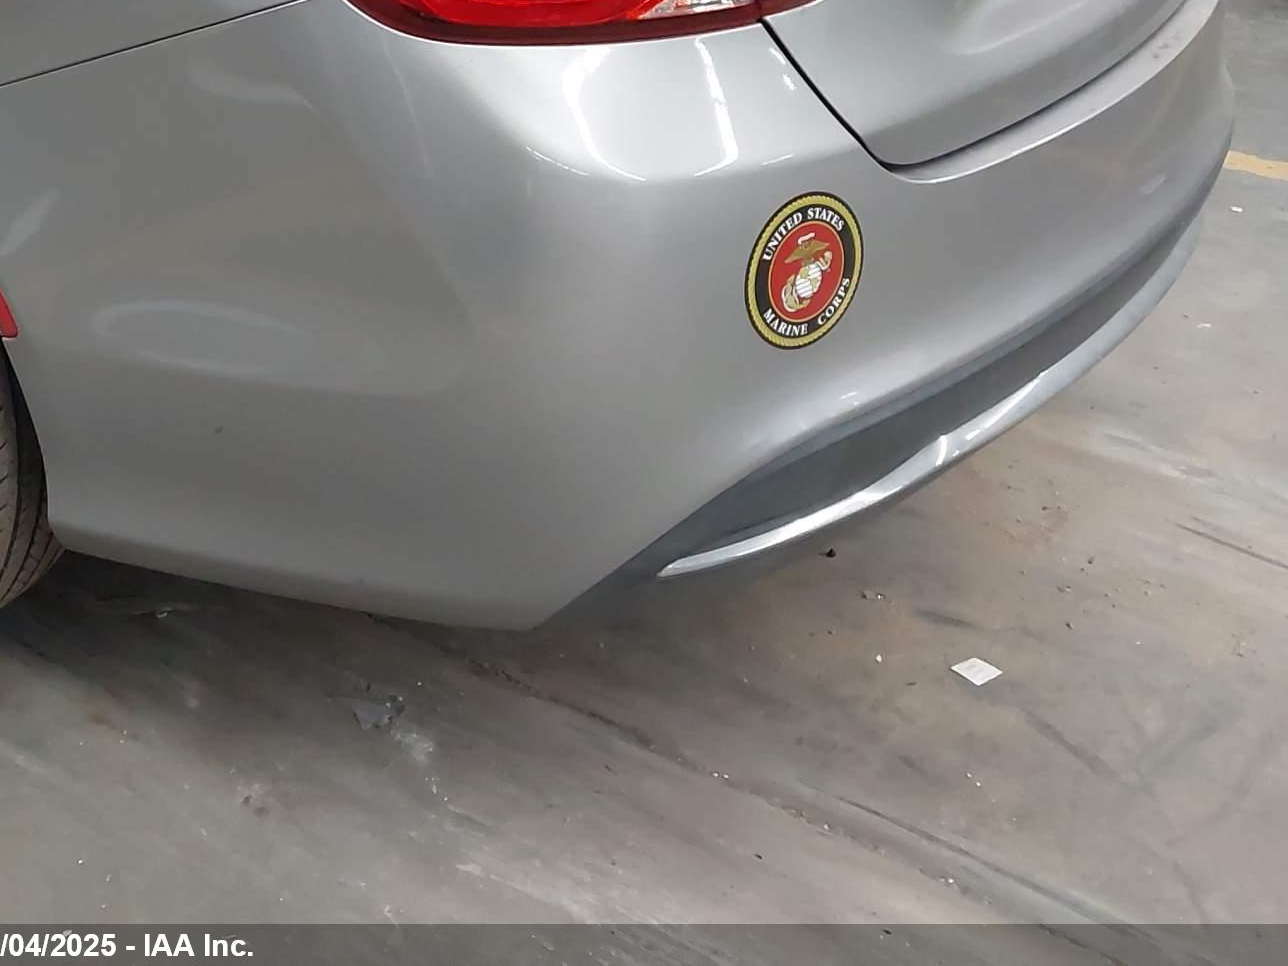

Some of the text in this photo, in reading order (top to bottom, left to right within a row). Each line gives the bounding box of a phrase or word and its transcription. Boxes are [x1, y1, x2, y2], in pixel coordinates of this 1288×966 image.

[762, 207, 845, 261] UNITED STATES
[763, 277, 851, 336] MARINE CORPS
